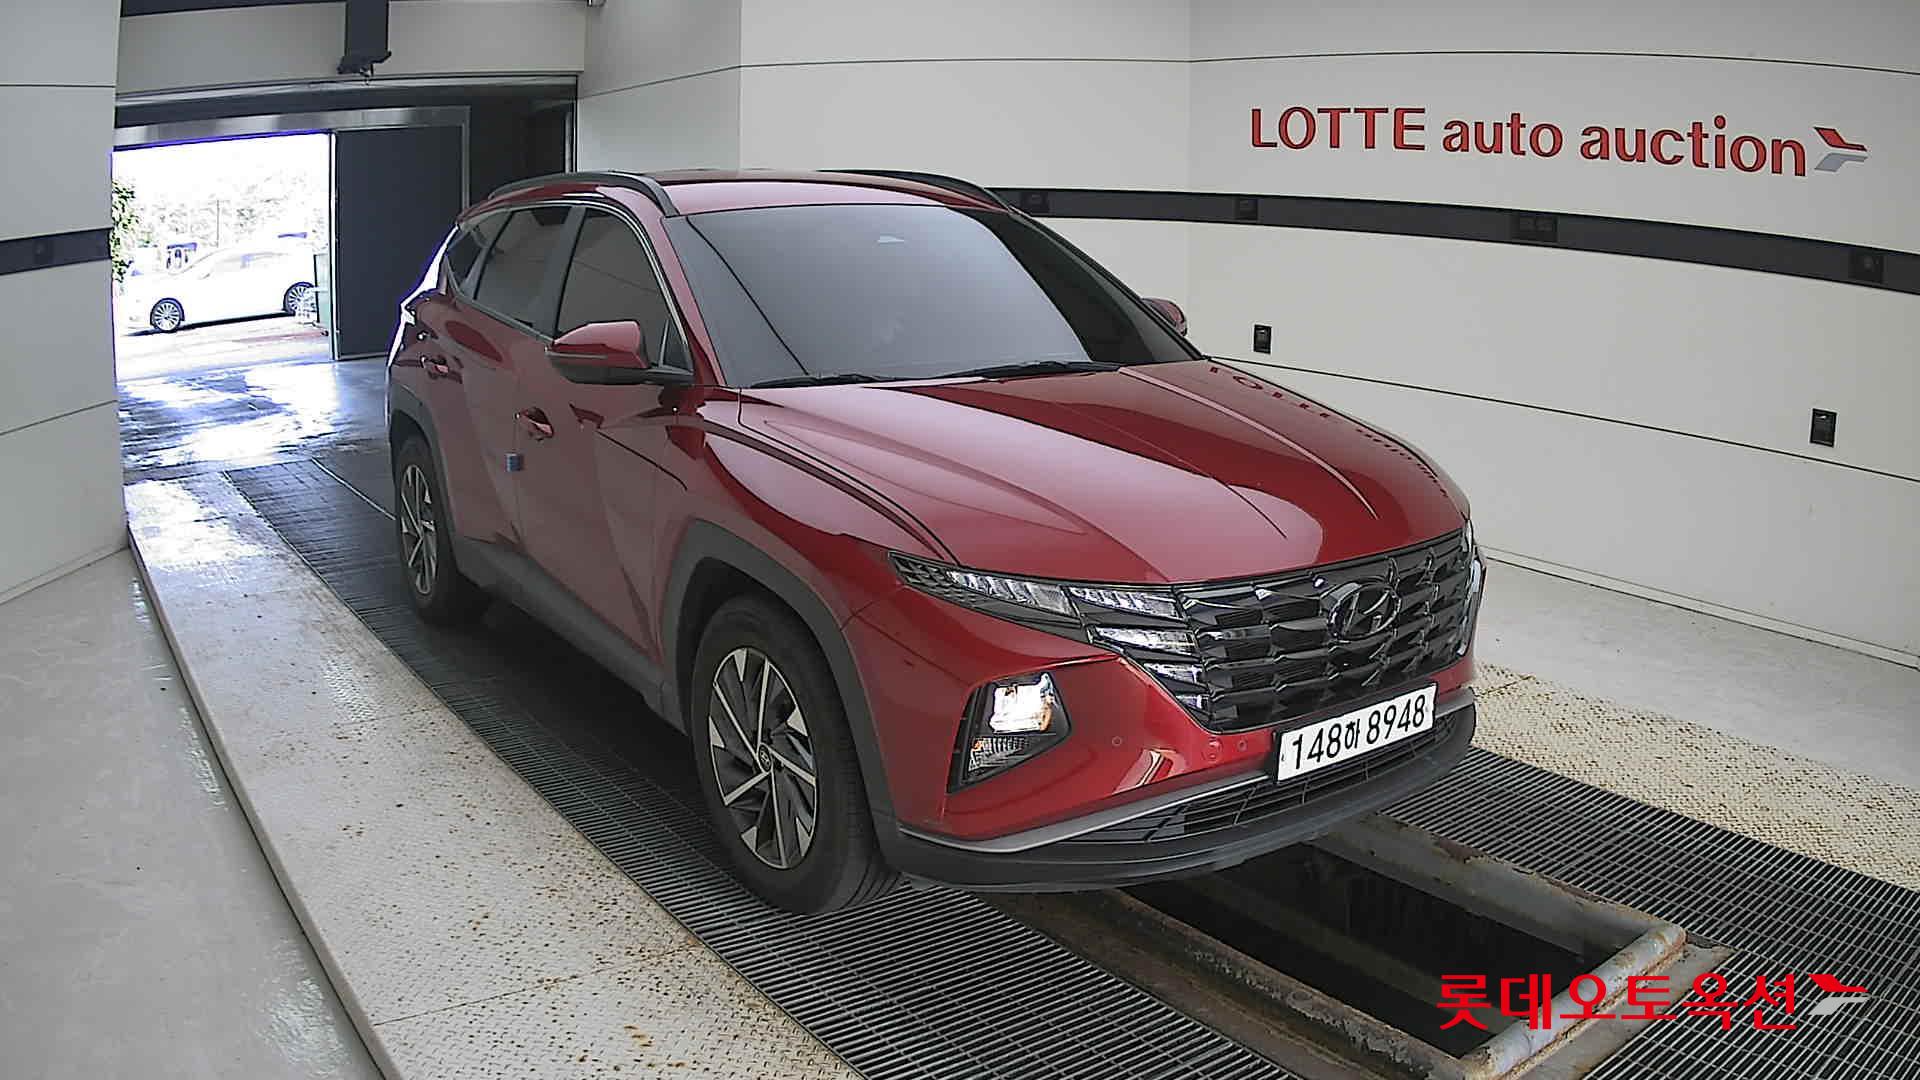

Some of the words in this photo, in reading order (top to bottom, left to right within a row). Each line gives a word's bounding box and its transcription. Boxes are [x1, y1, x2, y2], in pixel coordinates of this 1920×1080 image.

[1250, 107, 1425, 151] LOTTE
[1442, 112, 1563, 157] auto
[1580, 115, 1807, 177] auction
[1292, 718, 1361, 770] 148하
[1366, 694, 1426, 745] 8948
